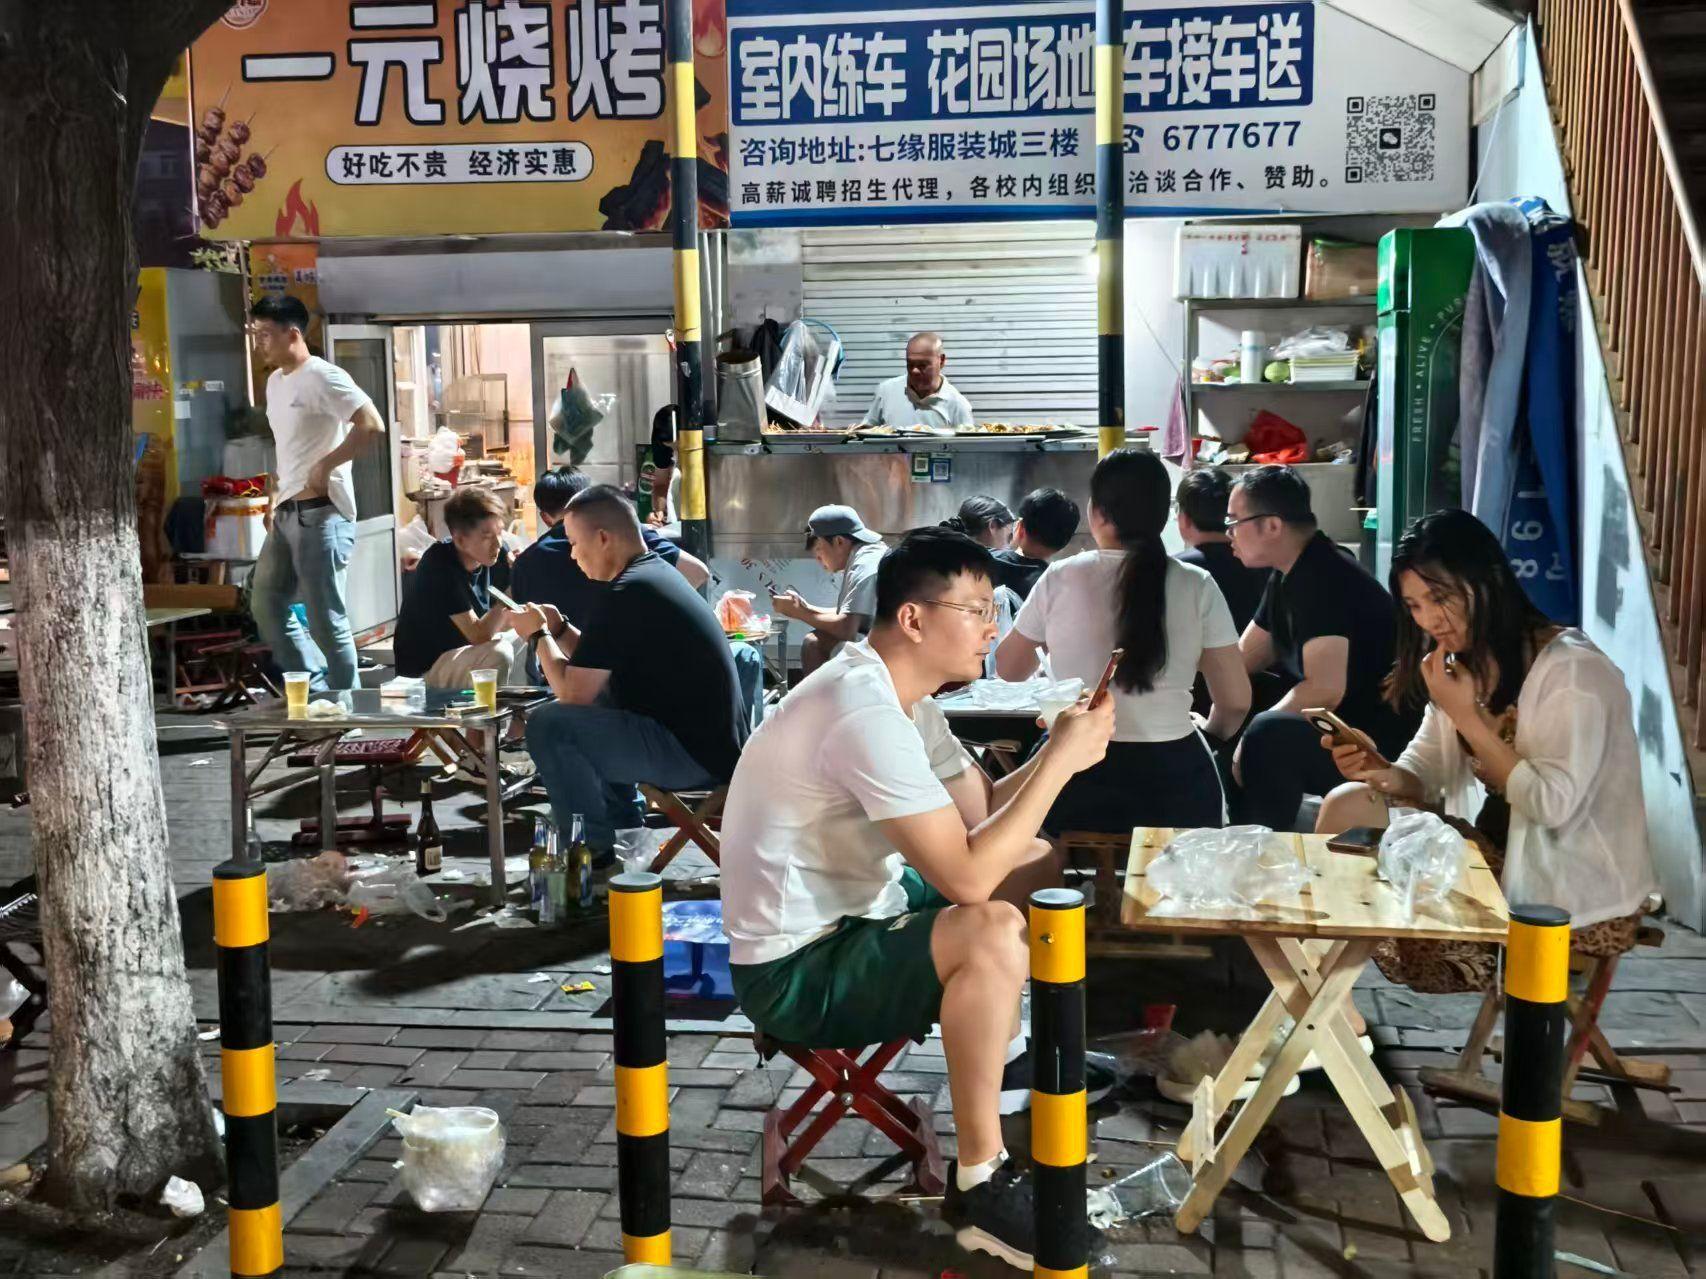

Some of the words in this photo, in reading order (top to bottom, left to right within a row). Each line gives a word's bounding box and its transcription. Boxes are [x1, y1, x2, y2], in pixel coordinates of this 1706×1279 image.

[242, 0, 665, 124] 一元烧烤
[740, 32, 907, 120] 室内练车
[927, 23, 1096, 114] 花园场地
[1122, 12, 1302, 106] 车接车送
[342, 150, 447, 178] 好吃不贵
[469, 147, 577, 177] 经济实惠
[740, 127, 1079, 167] 咨询地址:七缘服装城三楼
[1163, 121, 1302, 151] 6777677
